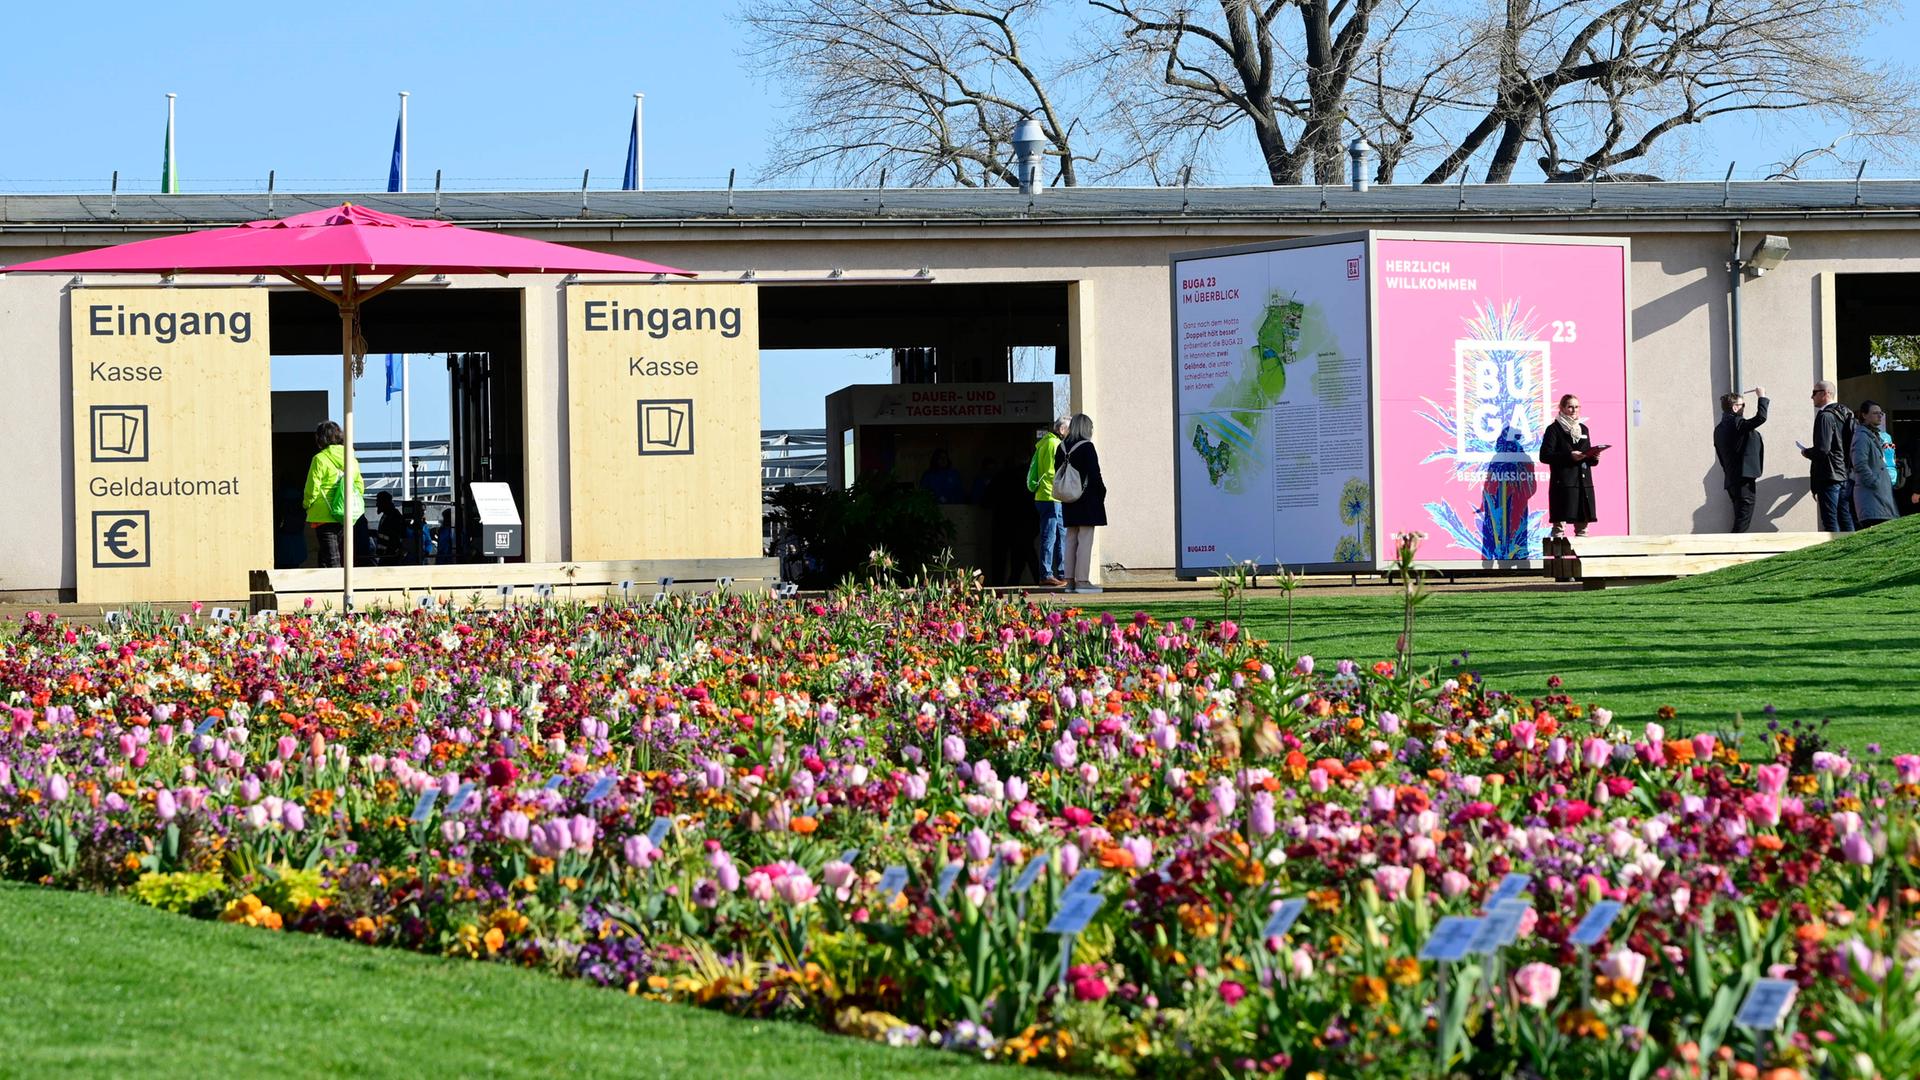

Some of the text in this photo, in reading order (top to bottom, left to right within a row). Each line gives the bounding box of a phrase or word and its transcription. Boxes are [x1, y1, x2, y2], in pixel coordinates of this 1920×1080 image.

[1386, 260, 1450, 273] HERZLICH
[1183, 277, 1216, 289] BUGA 23
[1386, 277, 1477, 291] WILLKOMMEN
[1183, 289, 1239, 304] IM ÜBERBLICK
[90, 305, 252, 344] Eingang
[585, 301, 741, 339] Eingang
[1183, 318, 1239, 330] Ganz nach dem Motto
[1552, 320, 1577, 343] 23
[1190, 351, 1216, 359] Mannheim
[1217, 349, 1229, 357] zwei
[90, 361, 163, 382] Kasse
[629, 356, 699, 377] Kasse
[1475, 360, 1533, 399] BU
[912, 391, 996, 402] DAUER- UND
[906, 405, 1002, 416] TAGESKARTEN
[1473, 403, 1532, 441] GA
[1457, 472, 1488, 481] BESTE
[89, 476, 240, 497] Geldautomat
[1187, 545, 1216, 553] BUGA23.DE
